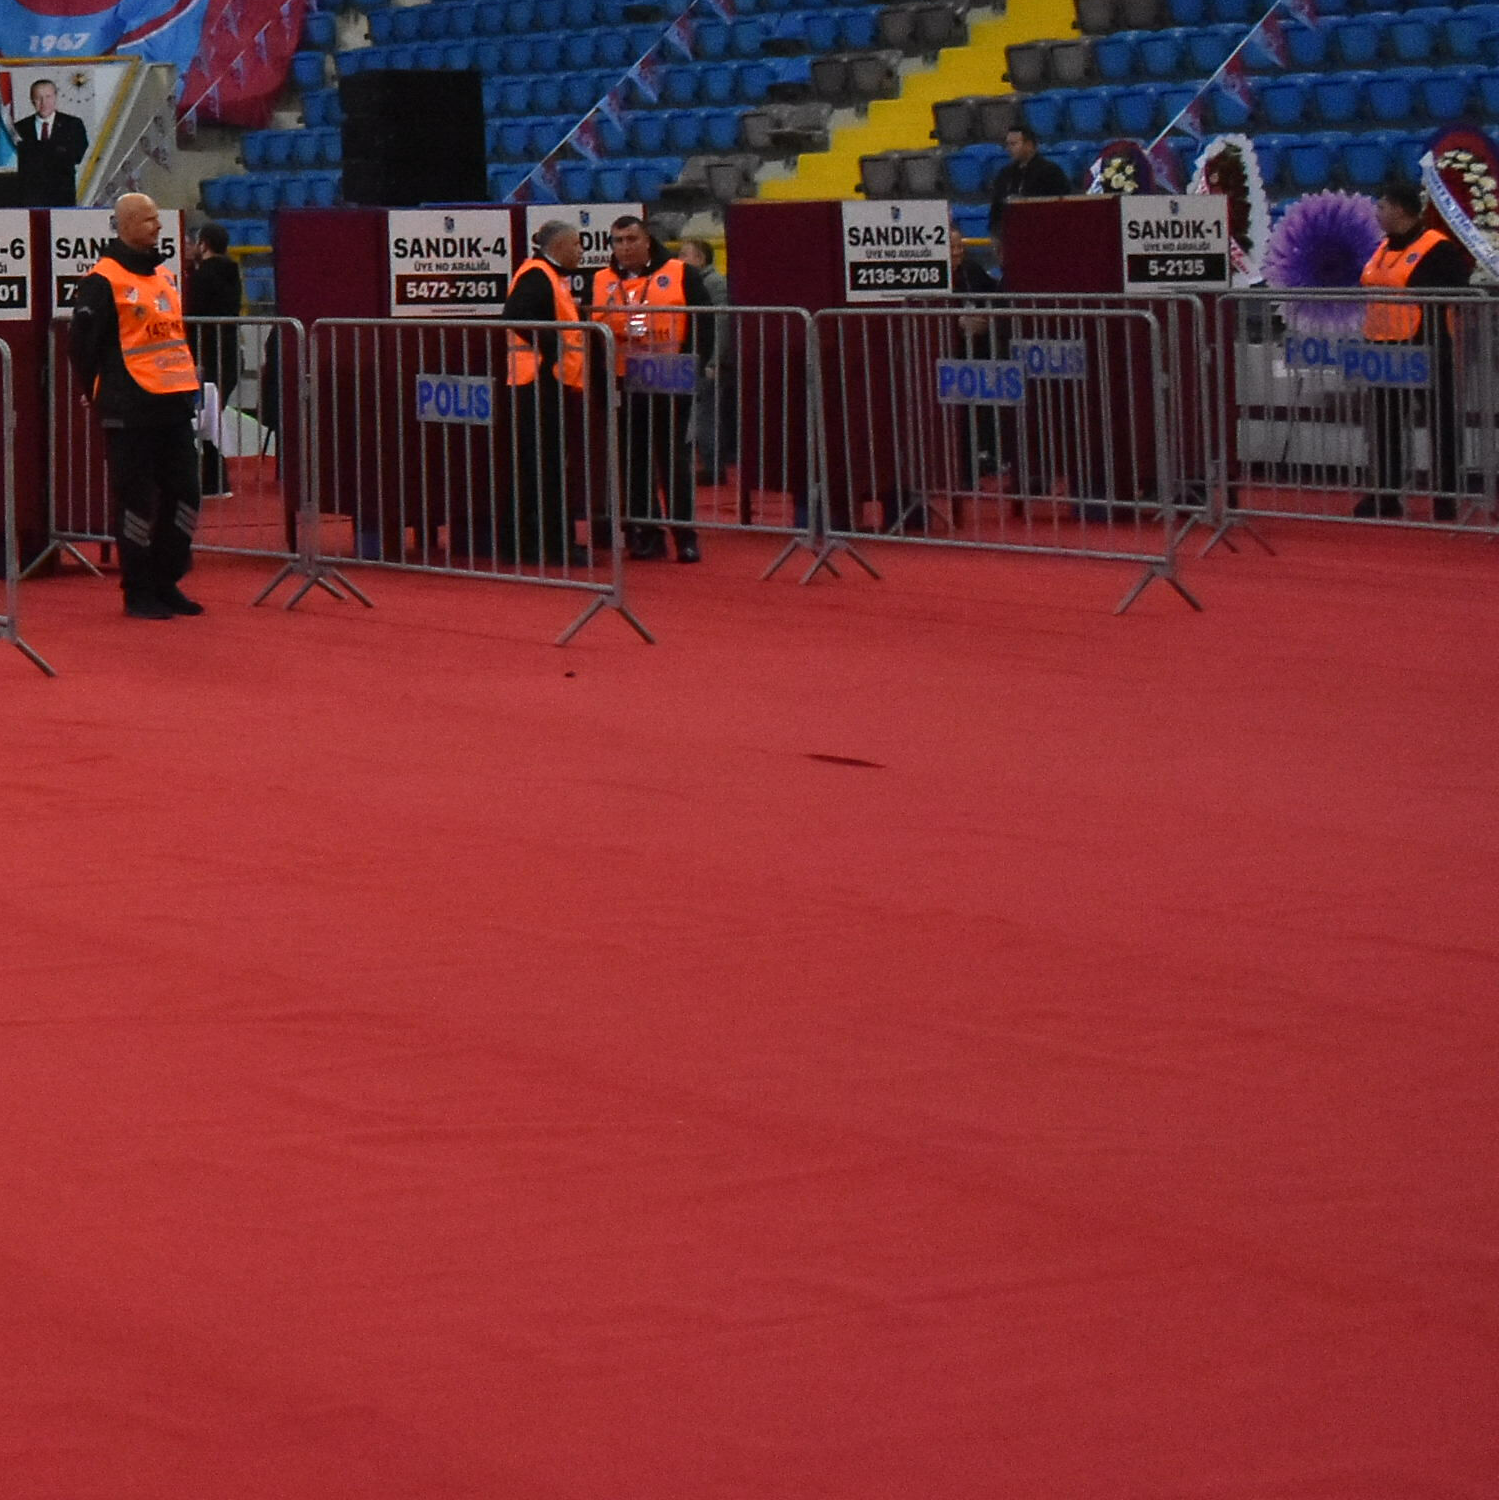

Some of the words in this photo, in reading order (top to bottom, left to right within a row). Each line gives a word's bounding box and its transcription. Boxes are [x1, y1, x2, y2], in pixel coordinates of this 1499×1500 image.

[28, 32, 90, 53] 1967
[848, 225, 945, 246] SANDIK-2
[1127, 220, 1222, 239] SANDIK-1
[394, 237, 507, 258] SANDIK-4
[857, 267, 940, 284] 2136-3708
[1148, 260, 1205, 276] 5-2135
[406, 281, 497, 298] 5472-7361
